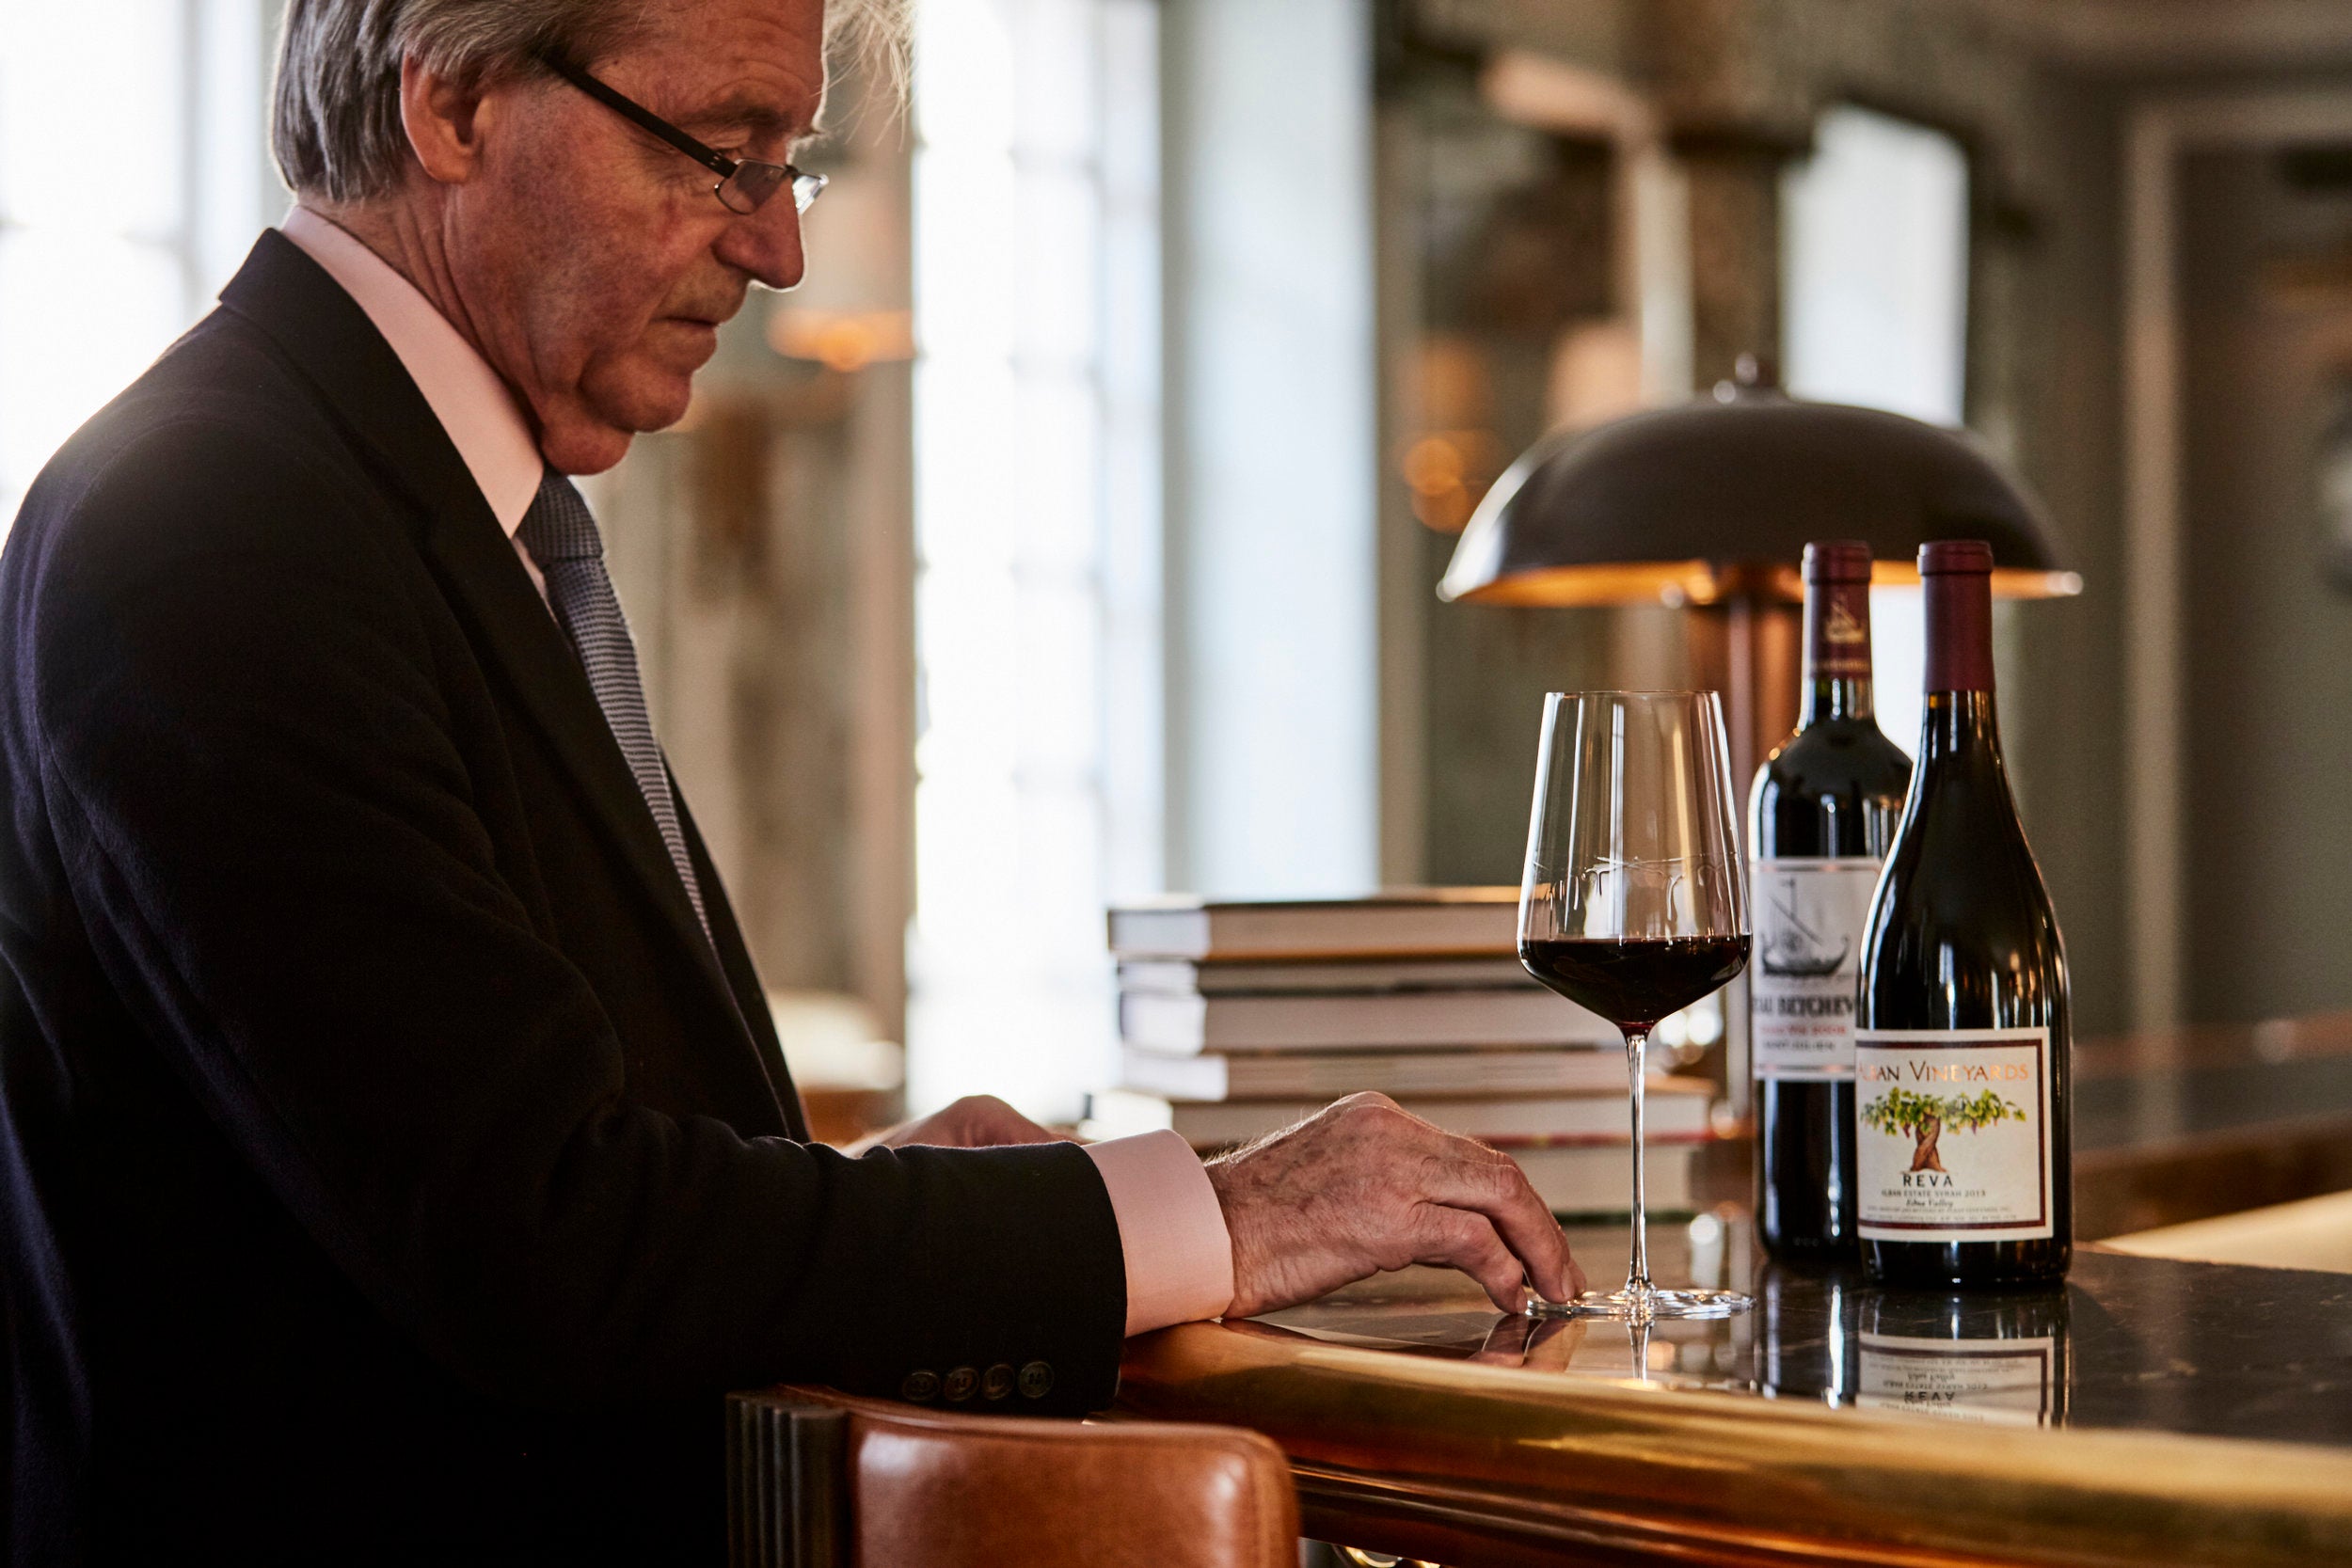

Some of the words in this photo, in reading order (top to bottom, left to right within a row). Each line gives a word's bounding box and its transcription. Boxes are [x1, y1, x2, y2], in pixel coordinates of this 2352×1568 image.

[1909, 1060, 2029, 1082] VINEYARDS
[1902, 1174, 1953, 1188] REVA
[1903, 1189, 1931, 1198] ESTATE
